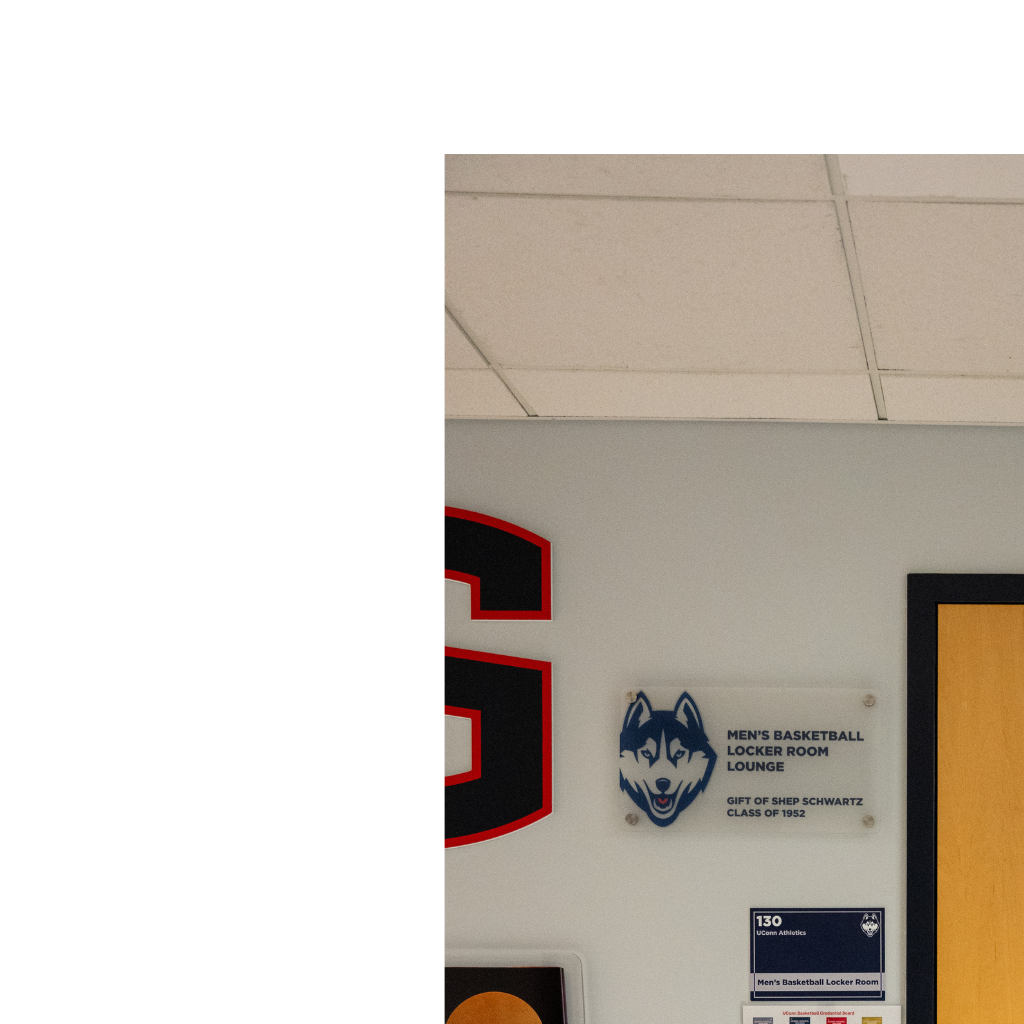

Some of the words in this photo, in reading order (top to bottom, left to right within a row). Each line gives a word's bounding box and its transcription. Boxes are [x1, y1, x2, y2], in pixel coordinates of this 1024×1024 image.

[727, 730, 770, 741] MEN'S
[774, 730, 864, 742] BASKETBALL
[727, 746, 783, 757] LOCKER
[786, 746, 829, 757] ROOM
[727, 761, 785, 772] LOUNGE
[727, 796, 751, 806] GIFT
[754, 796, 770, 806] OF
[772, 797, 800, 806] SHEP
[802, 797, 864, 806] SCHWARTZ
[727, 808, 762, 818] CLASS
[764, 809, 780, 818] OF
[782, 809, 806, 818] 1952
[756, 916, 782, 927] 130
